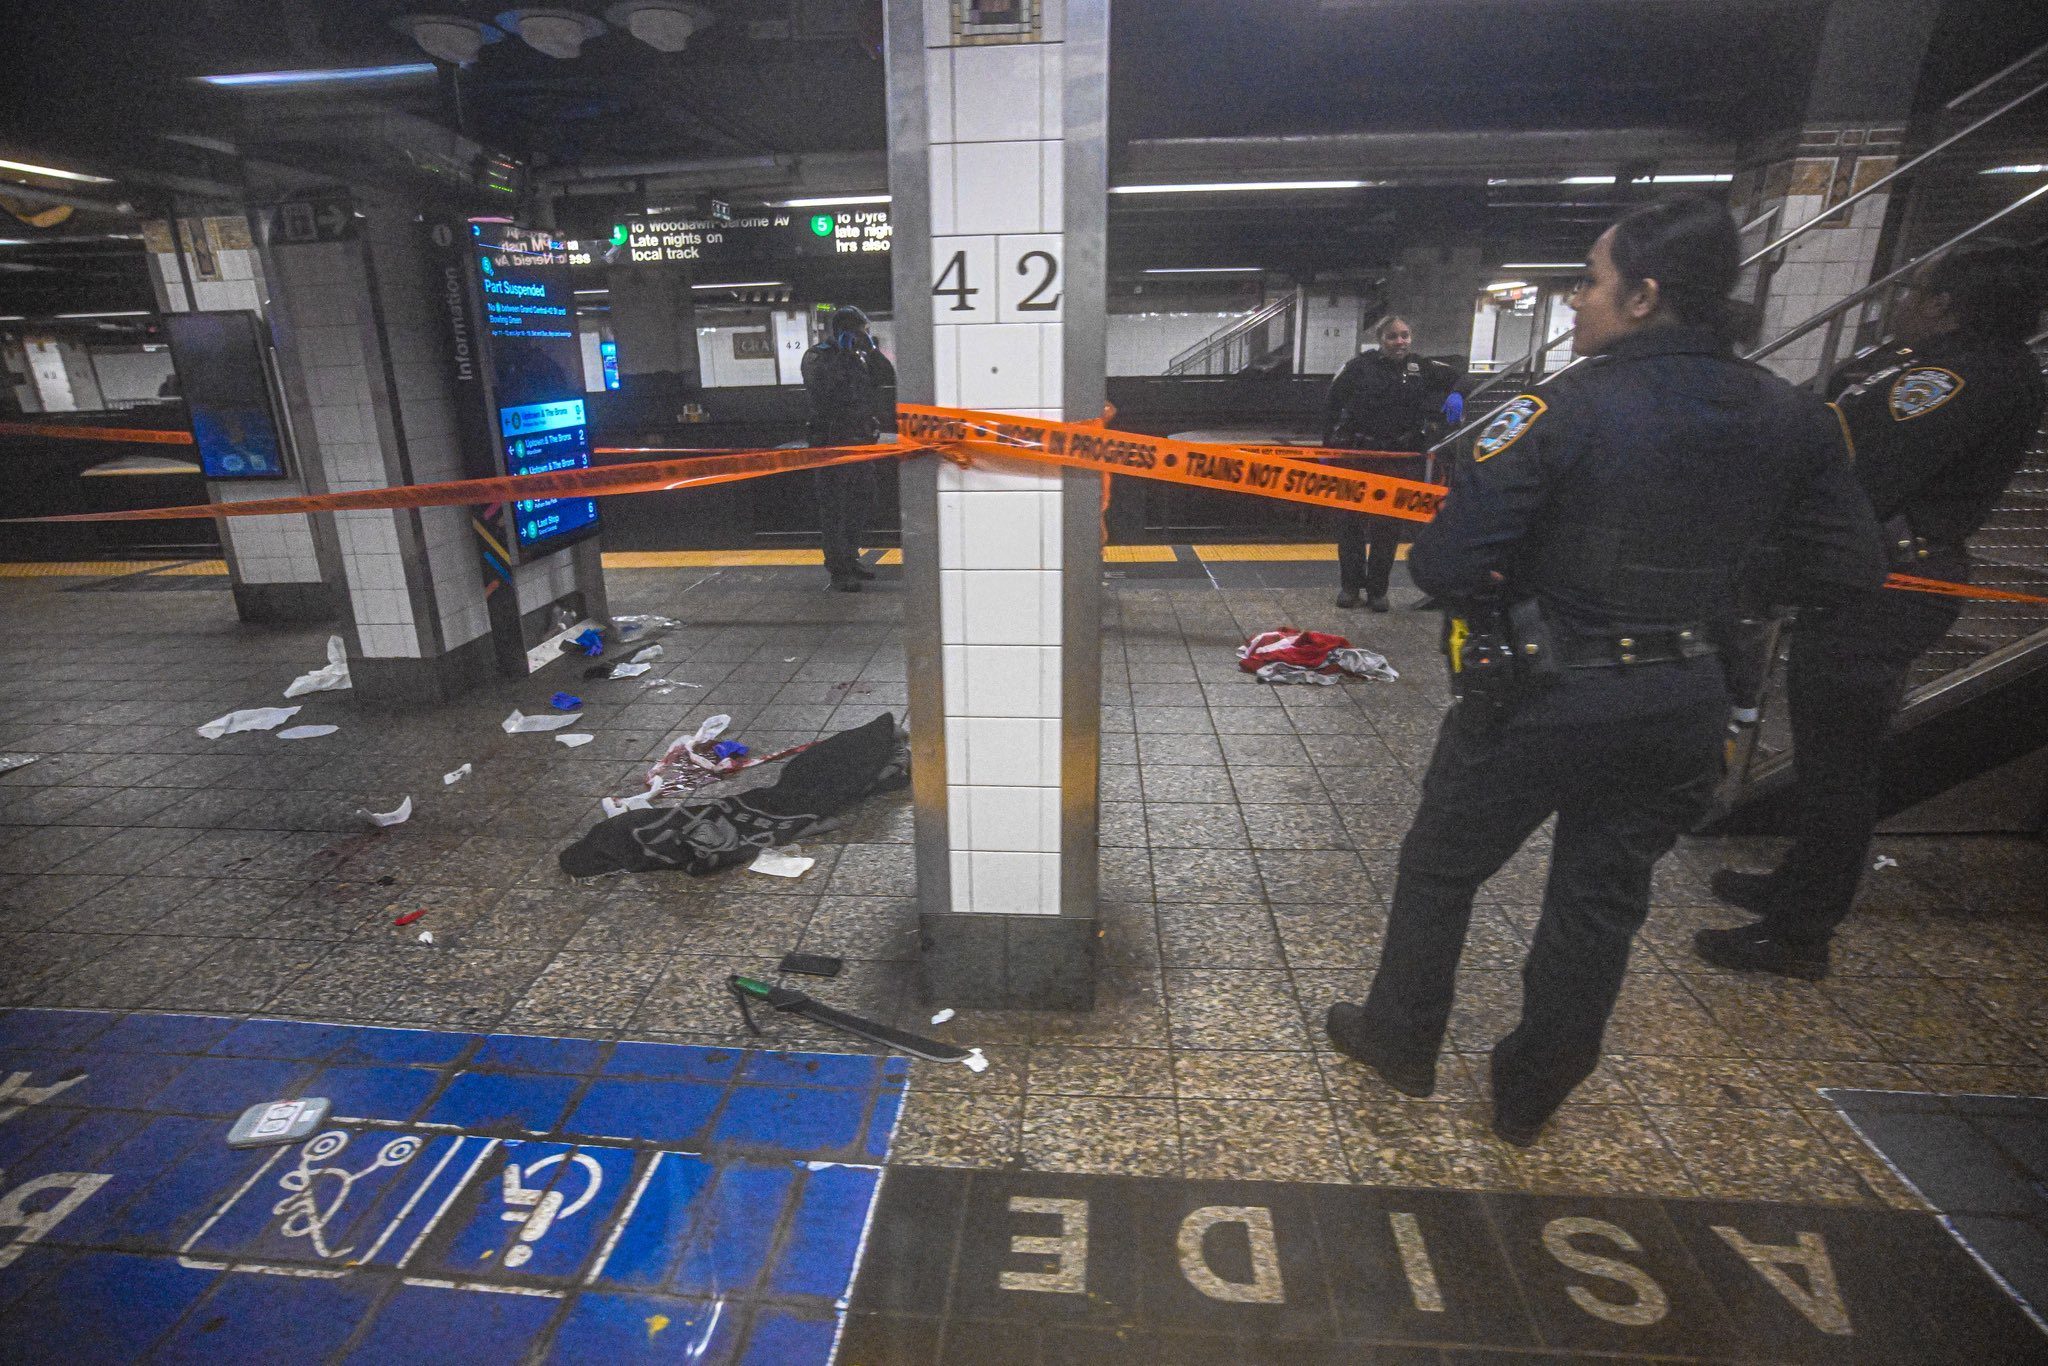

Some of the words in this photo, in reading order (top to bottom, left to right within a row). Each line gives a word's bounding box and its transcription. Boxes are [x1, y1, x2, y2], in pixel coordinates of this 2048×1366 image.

[854, 210, 887, 225] Dyre
[835, 225, 861, 238] late
[864, 223, 892, 239] nigh
[630, 232, 659, 248] Late
[663, 232, 702, 247] nights
[706, 232, 723, 243] on
[836, 239, 858, 252] hrs
[862, 237, 891, 252] also
[631, 247, 663, 261] local
[666, 246, 700, 259] track
[484, 278, 503, 294] Part
[503, 280, 546, 298] Suspended
[446, 267, 473, 381] Information
[558, 433, 572, 443] Bronx
[579, 429, 584, 440] 2
[562, 458, 575, 468] Bronx
[582, 454, 588, 465] 3
[1068, 432, 1157, 470] PROGRESS
[1185, 451, 1244, 484] TRAINS
[1244, 463, 1284, 489] NOT
[1283, 468, 1368, 503] STOPPING
[588, 501, 594, 513] 6
